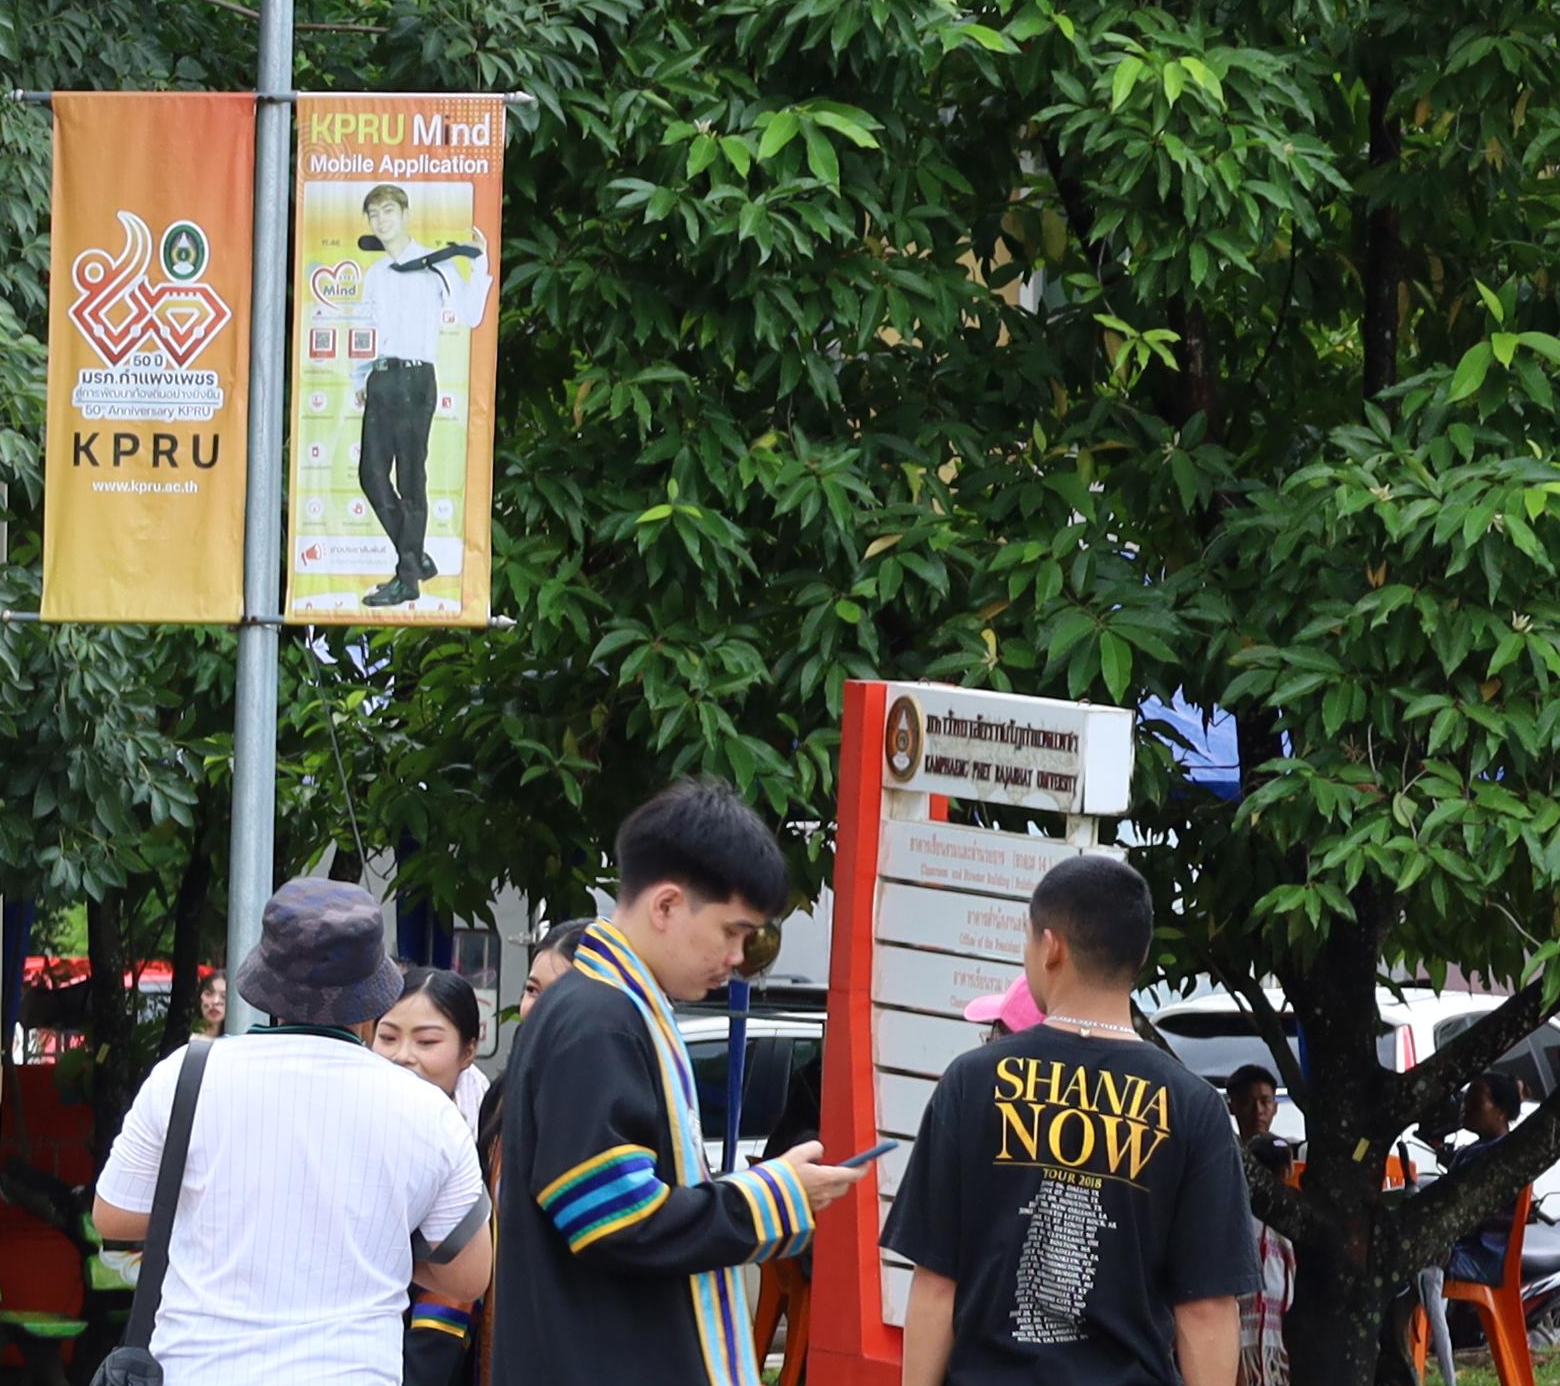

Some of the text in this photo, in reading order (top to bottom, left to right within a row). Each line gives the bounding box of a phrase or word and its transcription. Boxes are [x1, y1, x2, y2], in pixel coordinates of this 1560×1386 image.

[310, 113, 491, 147] KPRU Mind
[310, 154, 489, 178] Mobile Application
[322, 285, 357, 297] Mind
[133, 355, 151, 367] 50
[108, 404, 175, 419] Anniversary
[178, 406, 211, 416] KPRU
[92, 479, 198, 495] www.kpru.ac.th
[993, 1056, 1171, 1131] SHANIA
[993, 1101, 1171, 1181] NOW
[1042, 1167, 1103, 1189] TOUR 2018
